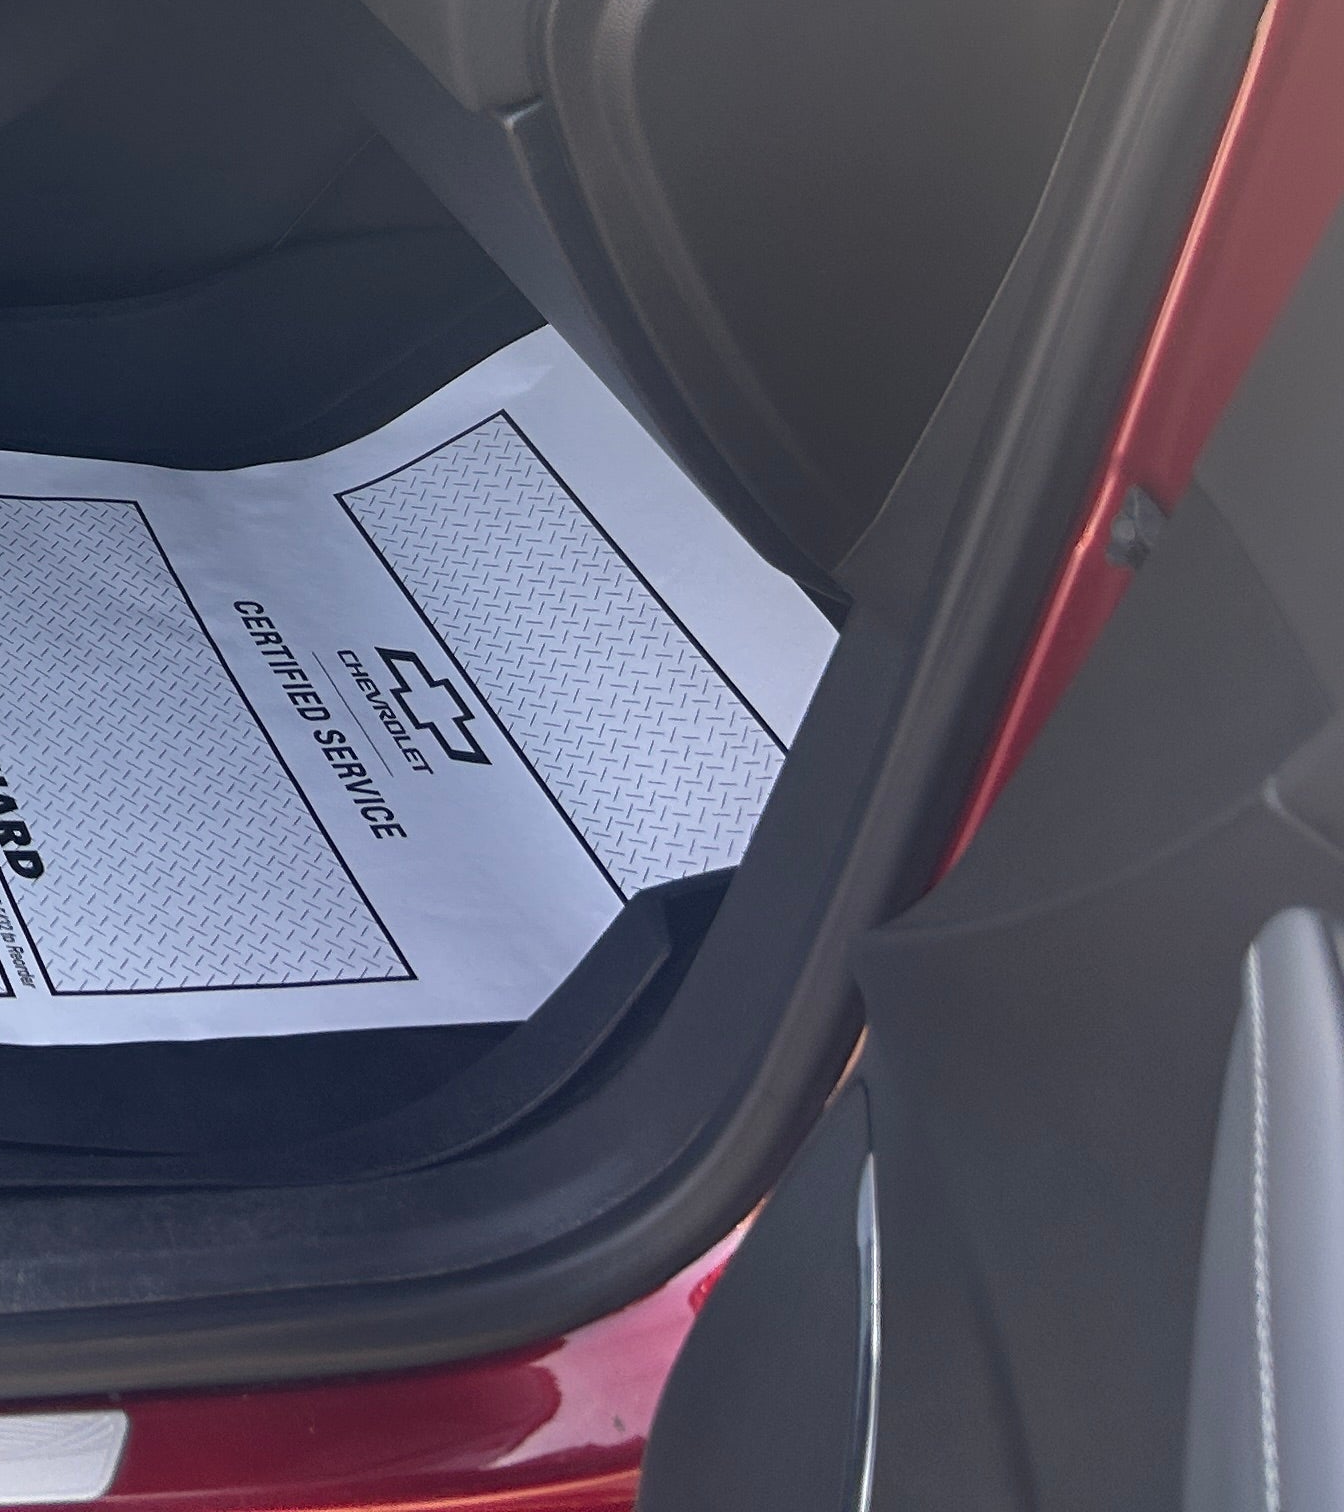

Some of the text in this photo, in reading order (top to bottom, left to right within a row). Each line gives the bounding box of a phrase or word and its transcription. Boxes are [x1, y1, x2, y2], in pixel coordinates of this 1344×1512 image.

[232, 599, 408, 840] CERTIFIED SERVICE
[335, 649, 435, 775] CHEVROLET
[0, 932, 17, 944] to
[5, 945, 37, 990] Reorder
